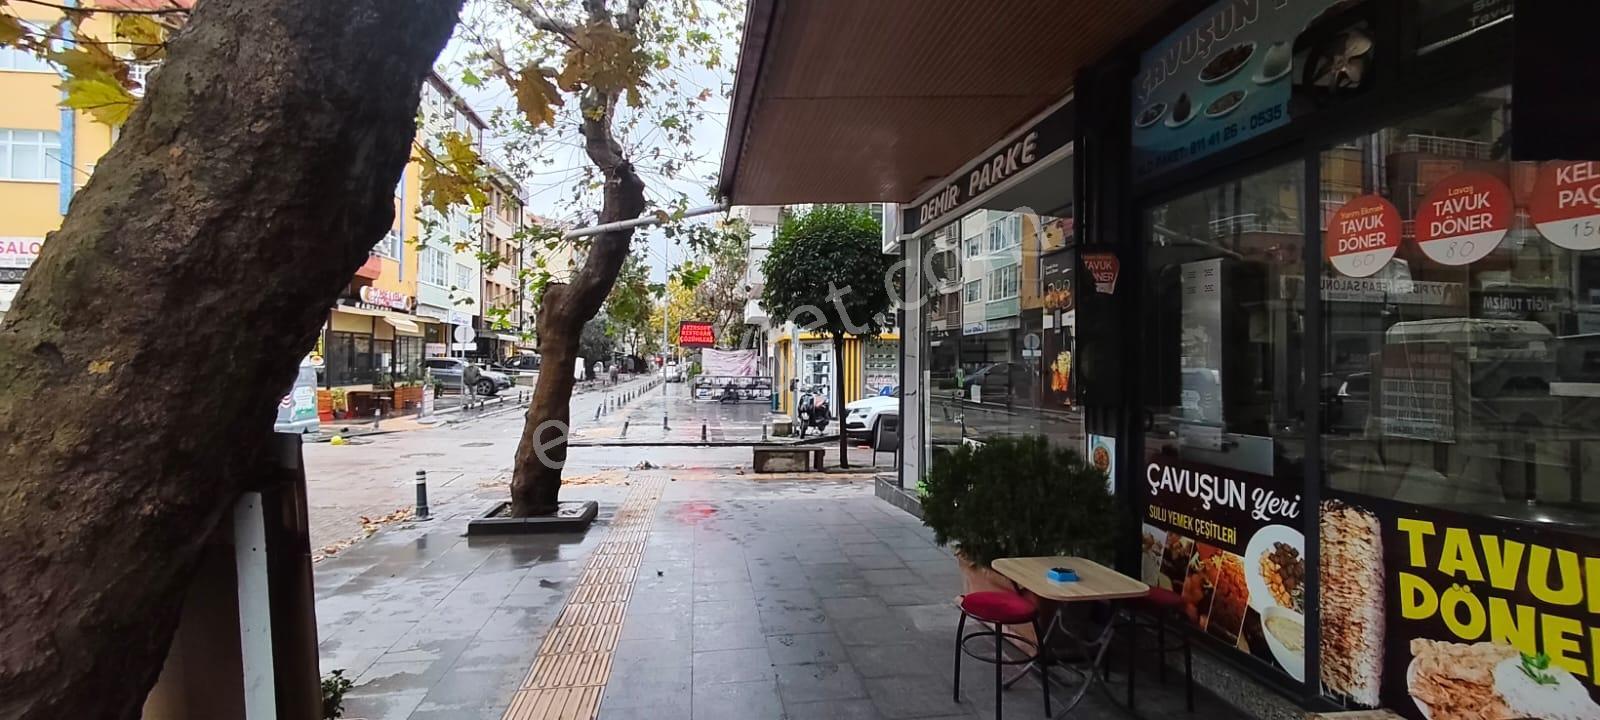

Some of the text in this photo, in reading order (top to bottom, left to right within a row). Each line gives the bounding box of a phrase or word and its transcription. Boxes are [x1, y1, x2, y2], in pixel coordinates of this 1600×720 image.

[1250, 104, 1282, 130] 0535
[920, 131, 1039, 225] DEMİR PARKE
[1448, 185, 1474, 197] Lavaş
[1432, 192, 1491, 216] TAVUK
[1340, 214, 1385, 234] TAVUK
[1431, 213, 1493, 237] DÖNER
[1572, 221, 1600, 238] 15
[1338, 232, 1386, 252] DÖNER
[1147, 463, 1301, 521] ÇAVUŞUN Yeri
[1149, 504, 1237, 545] SULU YEMEK ÇEŞİTLERİ
[1397, 518, 1600, 614] TAVU
[1399, 571, 1600, 687] DÖNE
